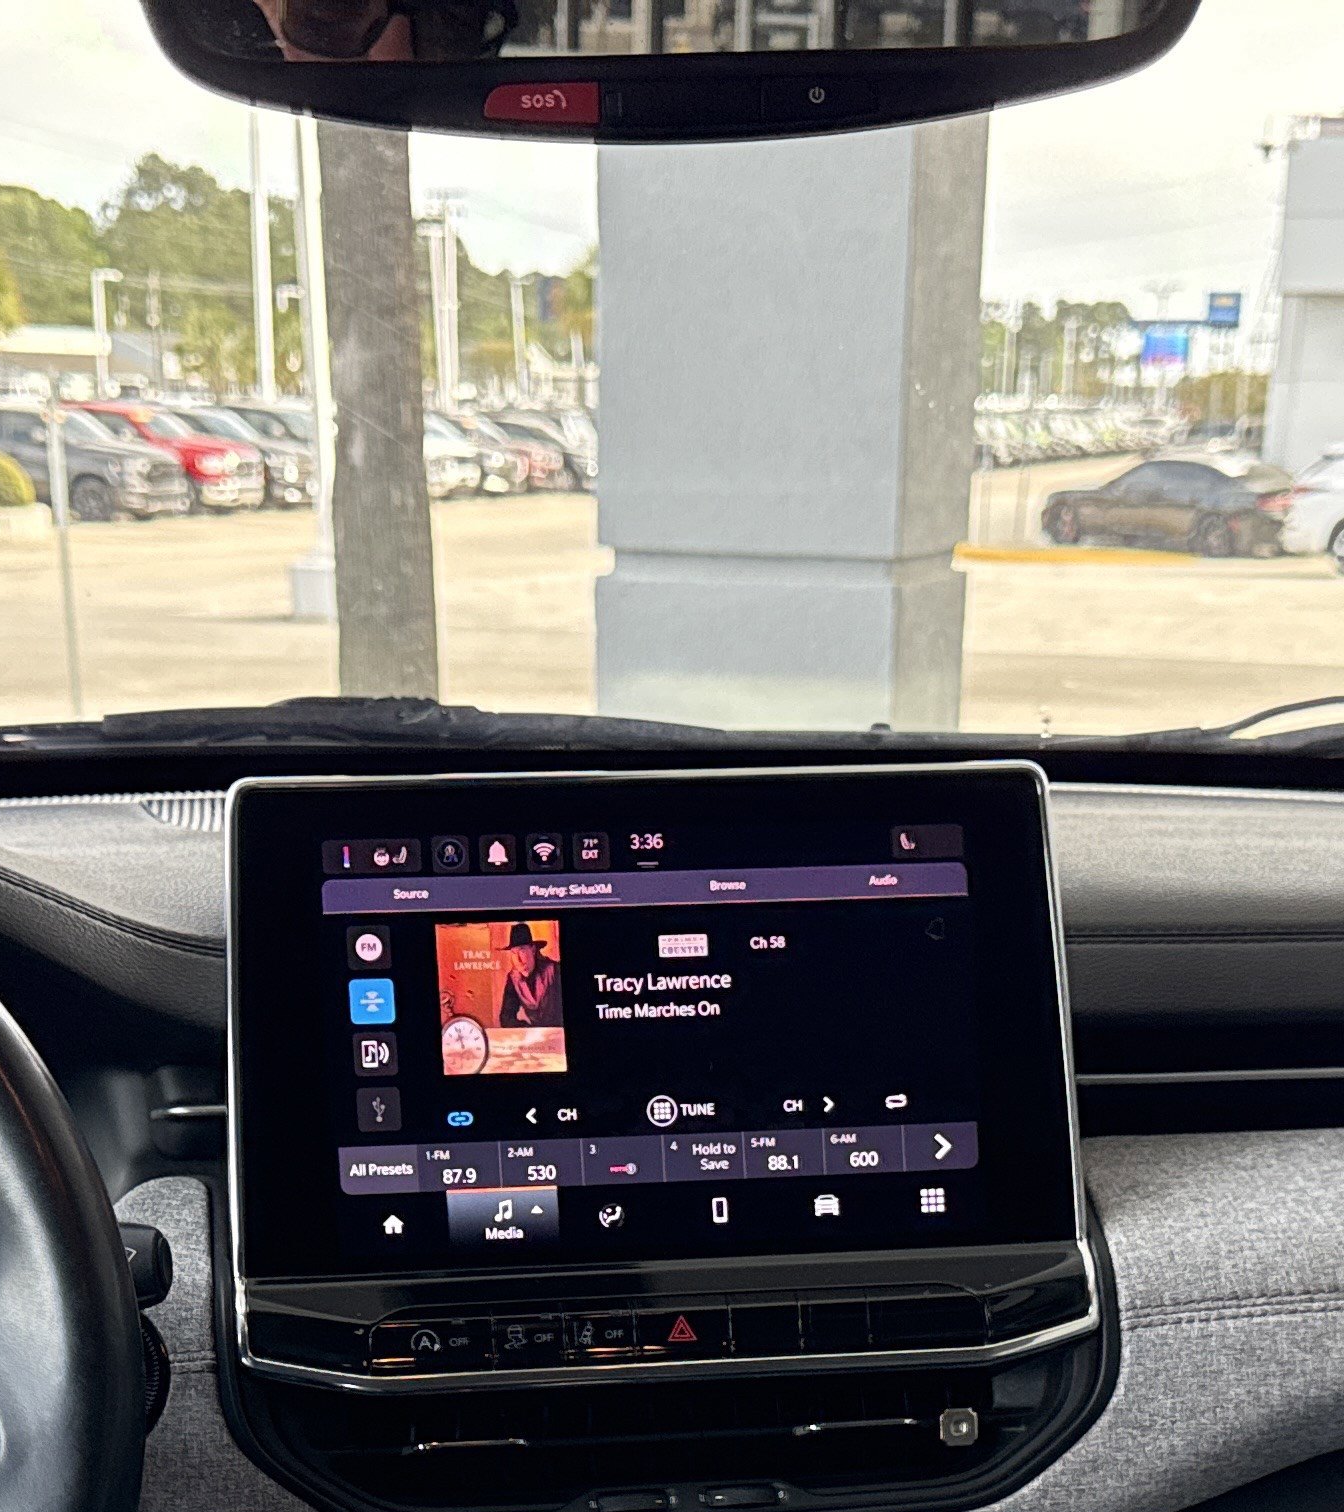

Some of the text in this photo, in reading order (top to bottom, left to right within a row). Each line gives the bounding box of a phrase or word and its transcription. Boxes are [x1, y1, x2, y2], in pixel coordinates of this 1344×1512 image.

[521, 94, 555, 109] SOS
[630, 833, 663, 850] 3:36
[709, 879, 746, 892] Browse
[869, 875, 898, 887] Audio
[393, 888, 429, 900] Source
[569, 883, 612, 896] SiriusXM
[360, 943, 377, 952] FM
[749, 936, 786, 949] Ch 58
[462, 951, 491, 960] TRACY
[454, 961, 500, 971] LAWRENCE
[594, 971, 732, 994] Tracy Lawrence
[596, 1000, 720, 1019] Time Marches On
[680, 1103, 715, 1116] TUNE
[783, 1099, 803, 1112] CH
[557, 1108, 577, 1121] CH
[830, 1133, 856, 1144] 6-AM
[426, 1149, 450, 1160] 1-FM
[507, 1147, 533, 1158] 2-AM
[692, 1141, 736, 1156] Hold to
[700, 1158, 730, 1171] Save
[767, 1155, 799, 1171] 88.1
[849, 1151, 879, 1168] 600
[349, 1162, 414, 1177] All Presets
[442, 1167, 477, 1184] 87.9
[527, 1164, 556, 1181] 530
[485, 1227, 524, 1240] Media
[533, 1333, 554, 1343] OFF
[604, 1329, 625, 1339] OFF
